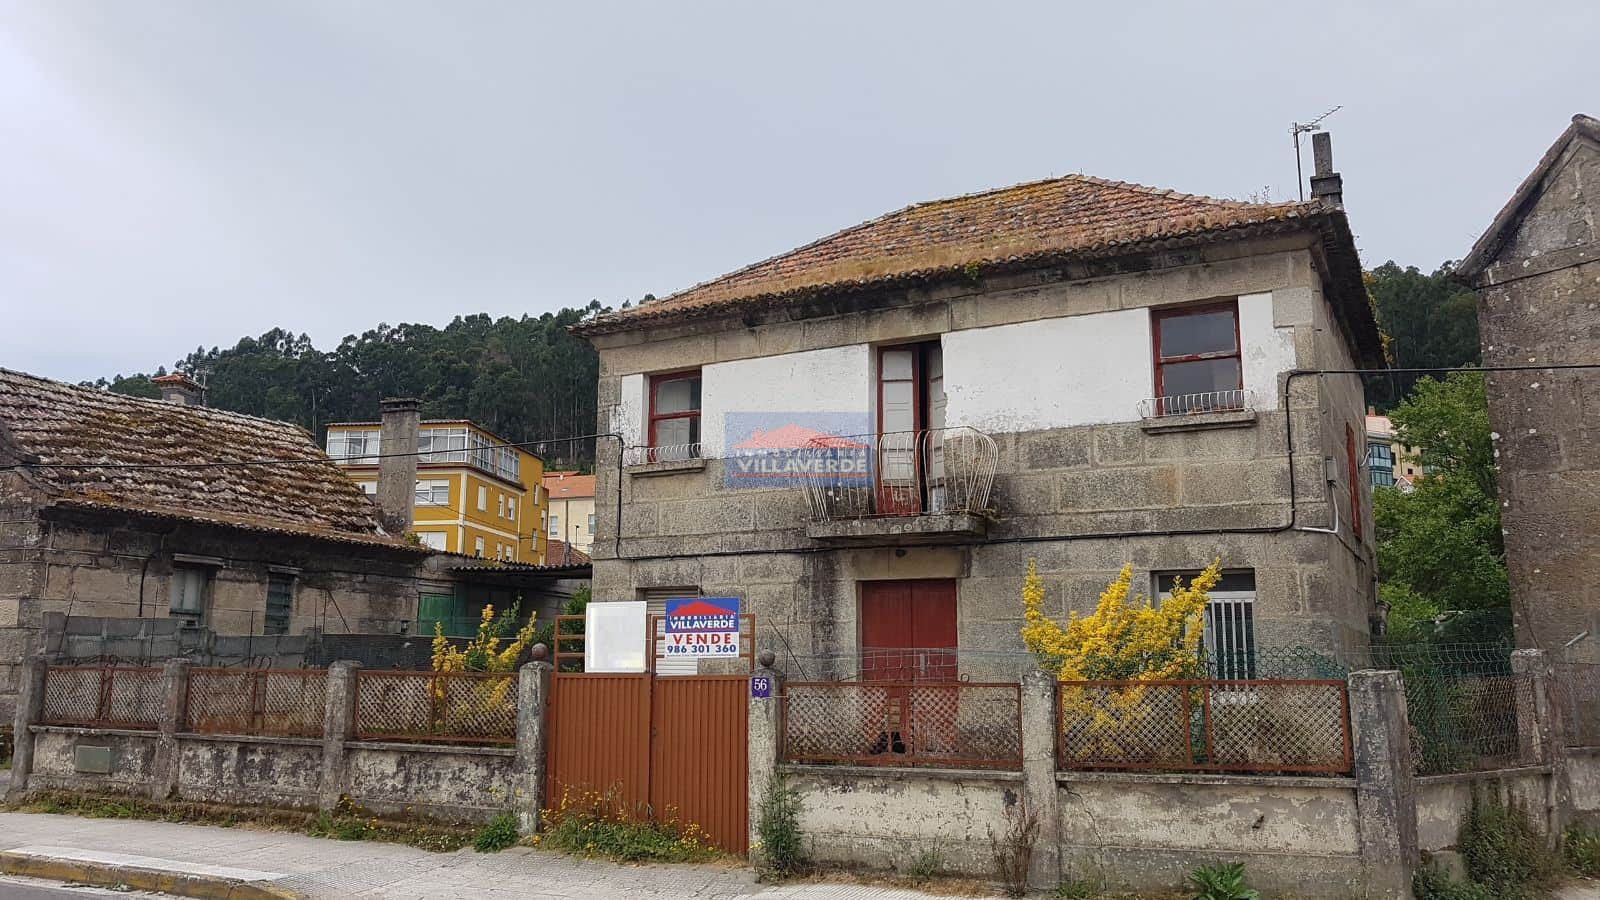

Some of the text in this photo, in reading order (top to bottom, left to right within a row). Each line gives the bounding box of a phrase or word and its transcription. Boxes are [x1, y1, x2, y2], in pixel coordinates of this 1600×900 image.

[670, 620, 735, 629] VILLAVERDE
[673, 633, 731, 645] VENDE
[667, 644, 737, 653] 986 301 360
[754, 678, 767, 691] 56
